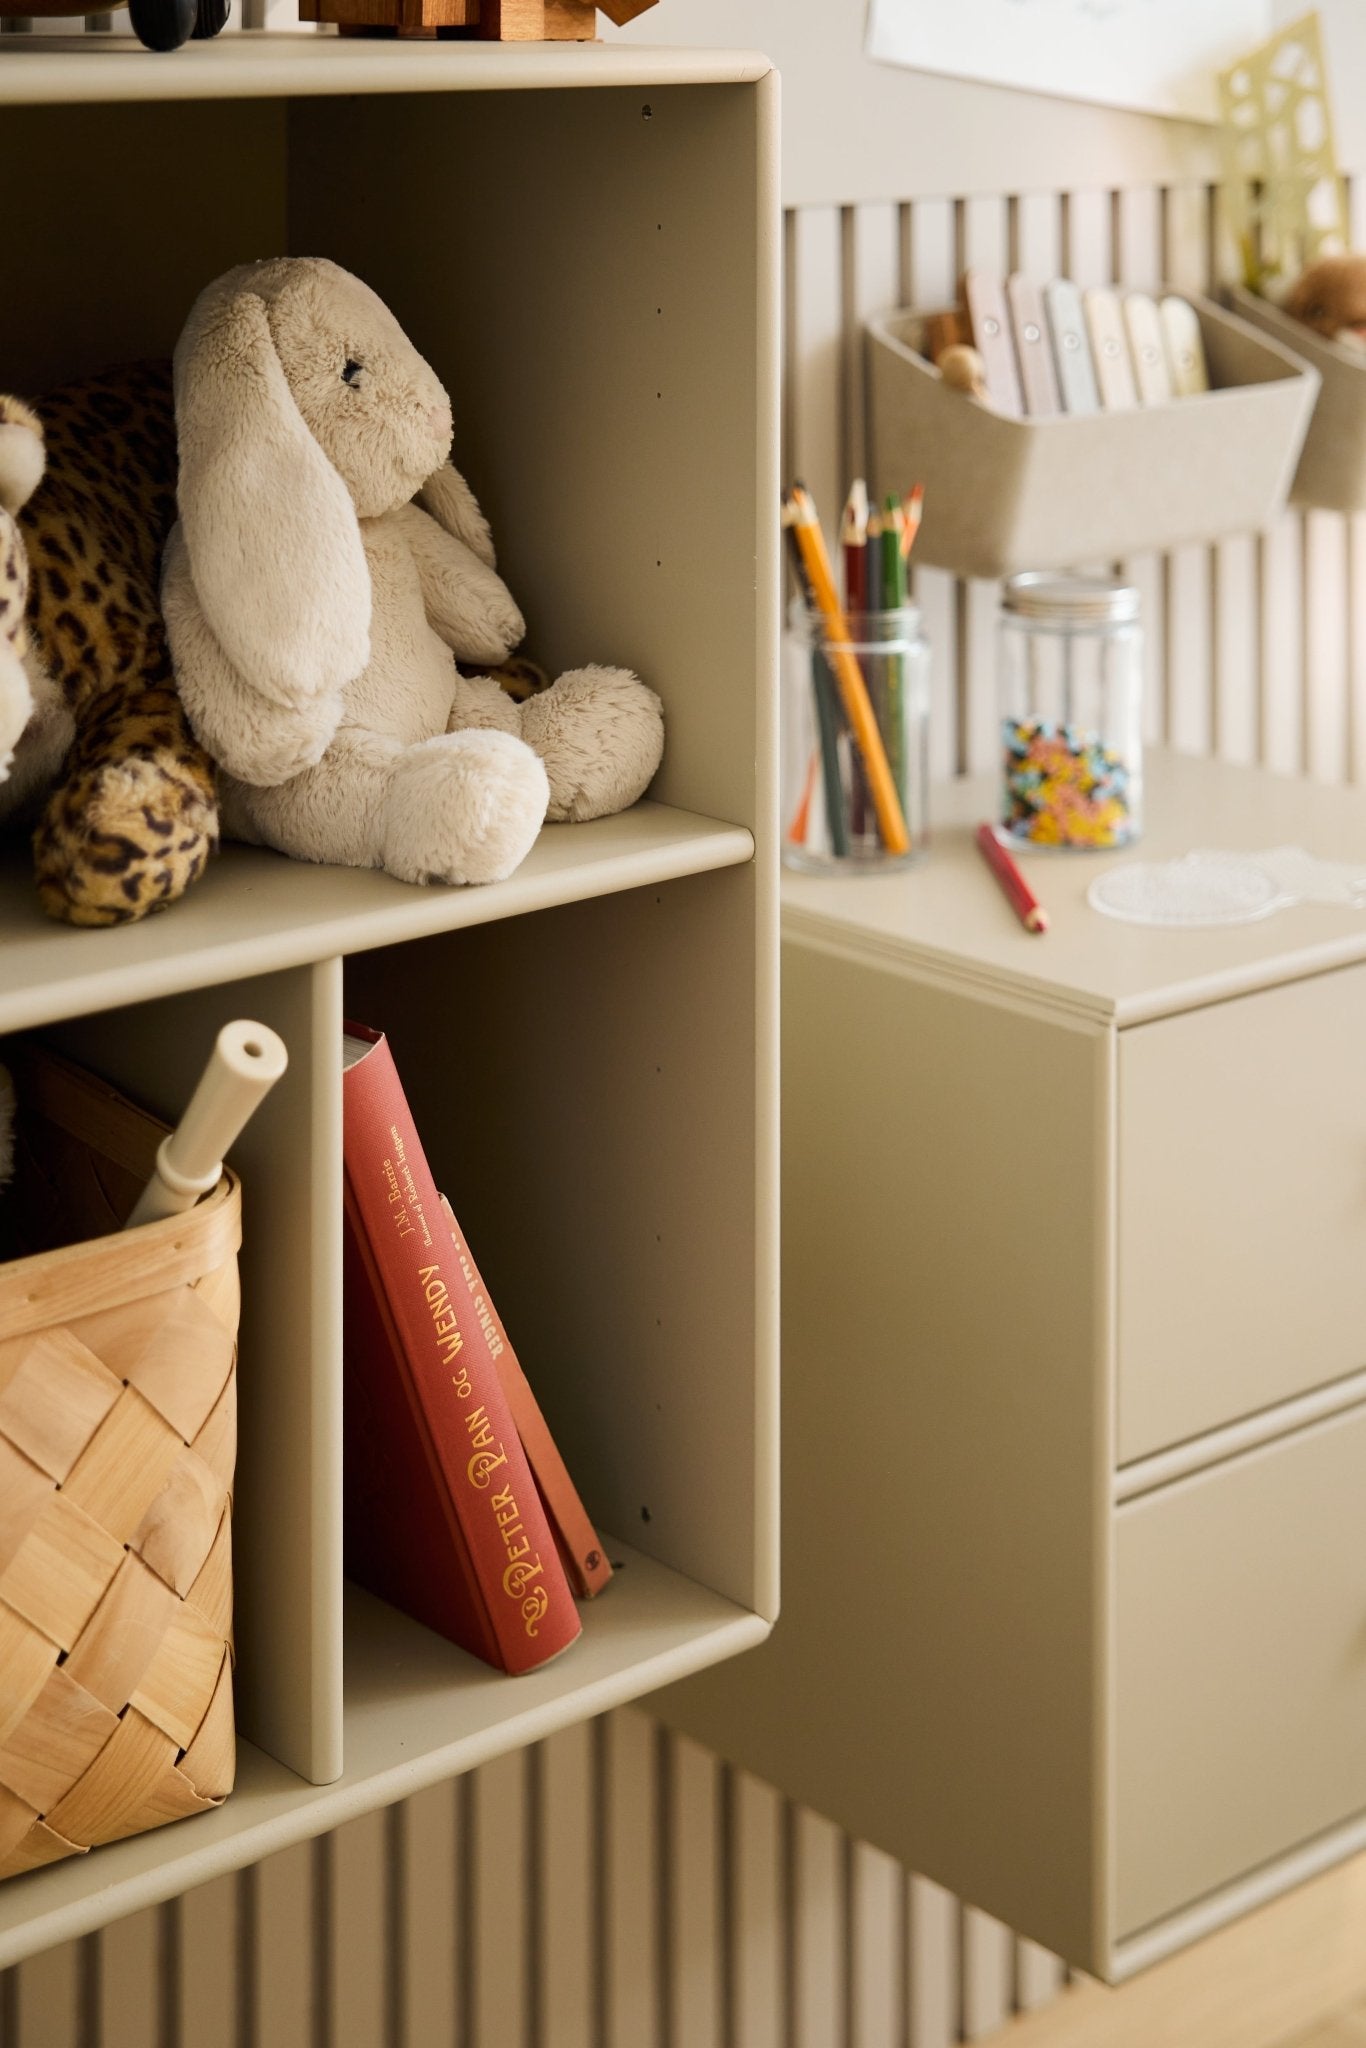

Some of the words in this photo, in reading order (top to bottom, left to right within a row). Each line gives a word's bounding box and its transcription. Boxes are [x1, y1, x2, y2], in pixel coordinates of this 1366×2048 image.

[390, 1125, 406, 1167] Ingpen
[382, 1159, 401, 1204] Barrie
[402, 1165, 418, 1204] Robert
[394, 1204, 415, 1238] J.M.
[418, 1264, 464, 1365] WENDY
[474, 1295, 504, 1360] SYNGER
